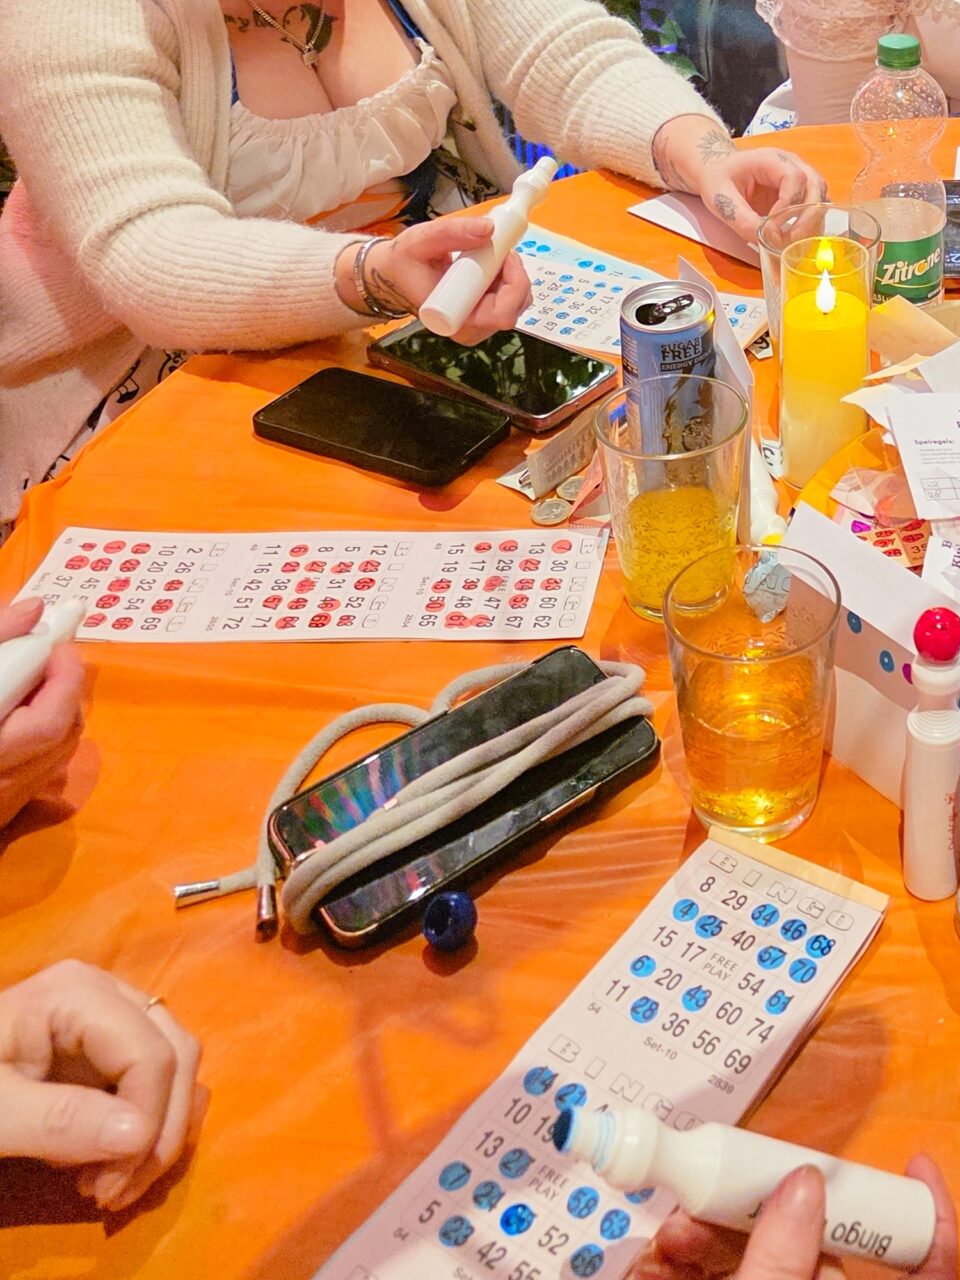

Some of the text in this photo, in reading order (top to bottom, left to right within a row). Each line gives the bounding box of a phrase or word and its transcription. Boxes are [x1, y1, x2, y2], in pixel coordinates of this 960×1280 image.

[881, 248, 941, 285] Zitrone
[660, 337, 701, 351] SUGAR
[661, 345, 702, 360] FREE
[662, 361, 693, 370] ENERGY
[124, 545, 178, 611] 10 32 54
[222, 562, 273, 630] 16 51 72
[345, 544, 389, 610] 12 52
[418, 543, 466, 627] 15 19 65
[454, 560, 487, 609] 17 48
[505, 542, 546, 629] 13 67
[532, 559, 568, 629] 30 60 62
[699, 876, 836, 956] 8 29 34 46 68
[708, 849, 856, 932] BINGO
[652, 925, 795, 1012] 15 17 FREE 54 61
[680, 901, 816, 984] 4 25 40 57 70
[702, 962, 731, 982] PLAY
[605, 978, 752, 1075] 11 28 36 56 69
[632, 955, 775, 1044] 6 20 43 60 74
[587, 1002, 736, 1095] 54 Set-10 2839
[504, 1097, 532, 1125] 10
[556, 1083, 587, 1106] 21
[475, 1130, 598, 1217] 13 FREE 58
[528, 1177, 559, 1202] PLAY
[418, 1200, 508, 1270] 5 42
[537, 1225, 570, 1256] 52
[831, 1221, 893, 1258] Bingo
